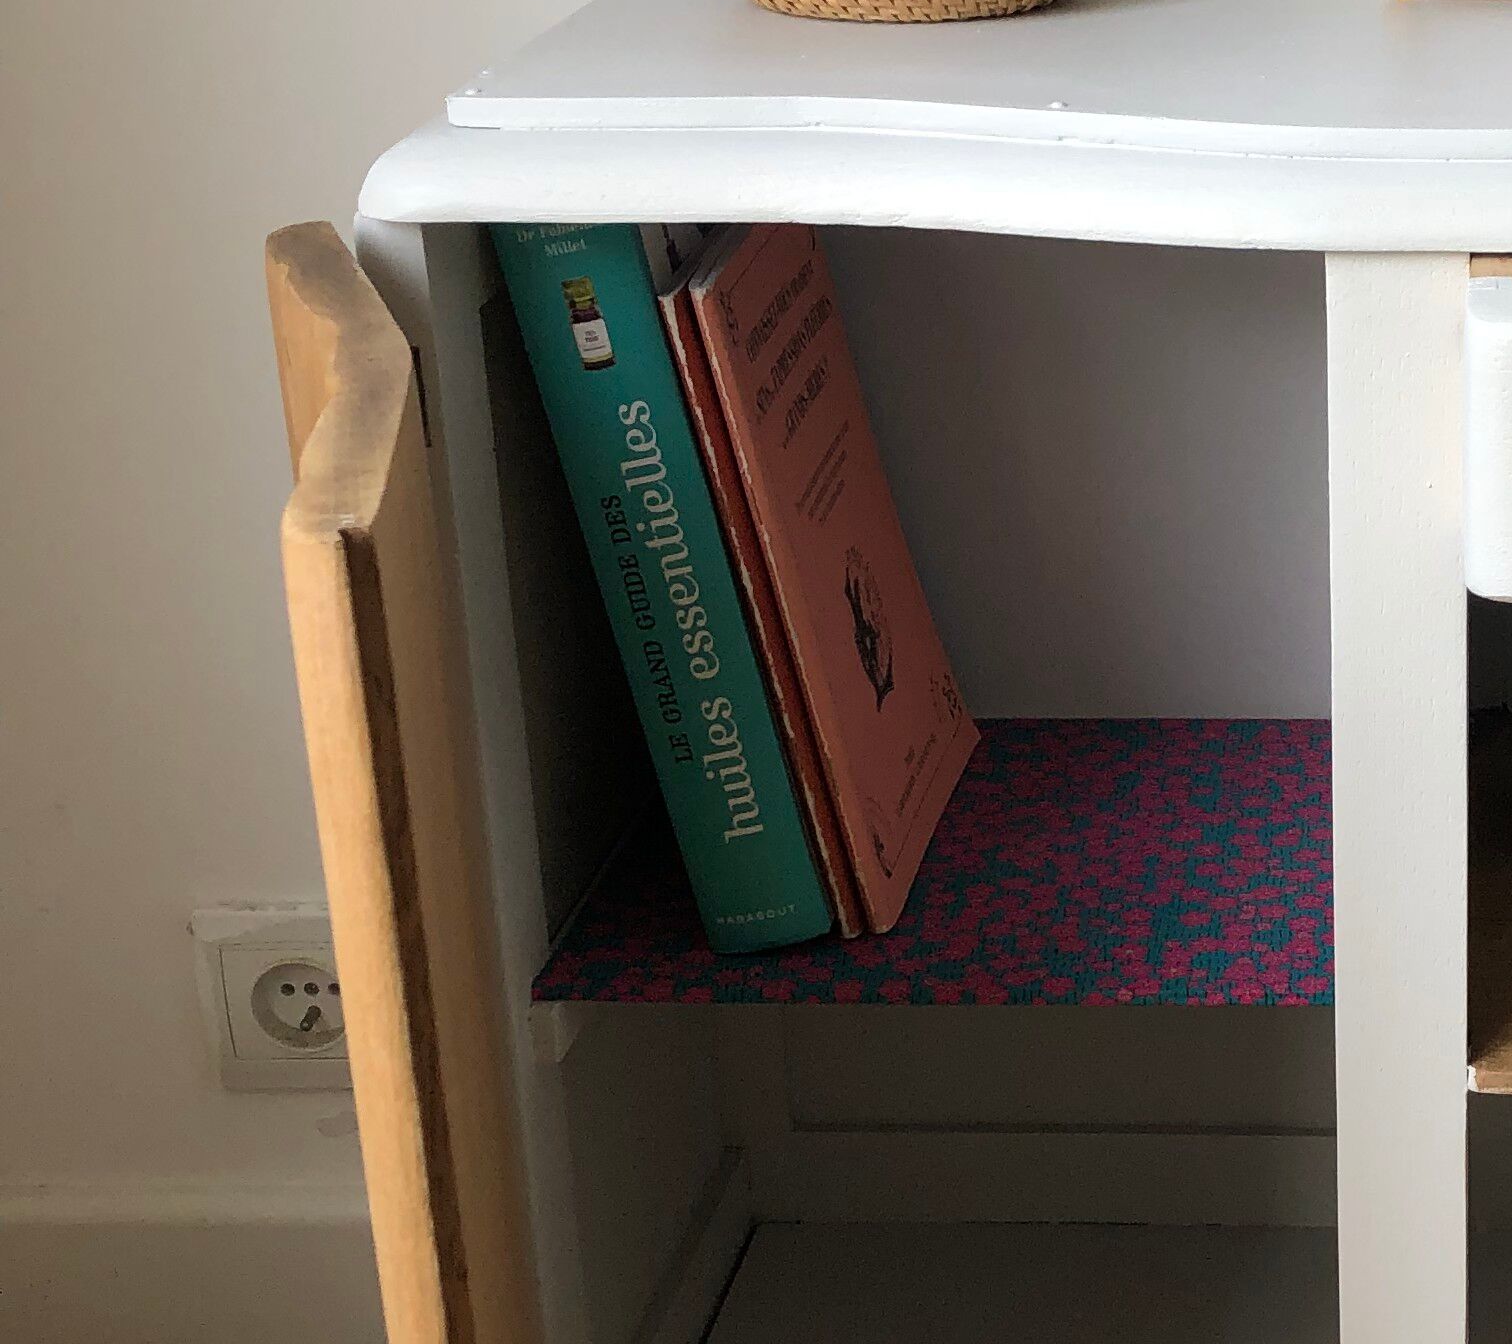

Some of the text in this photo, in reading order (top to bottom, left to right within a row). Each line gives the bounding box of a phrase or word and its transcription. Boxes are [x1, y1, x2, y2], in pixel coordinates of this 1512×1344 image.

[601, 494, 694, 764] LE GRAND GUIDE DES
[618, 399, 764, 844] huiles essentielles
